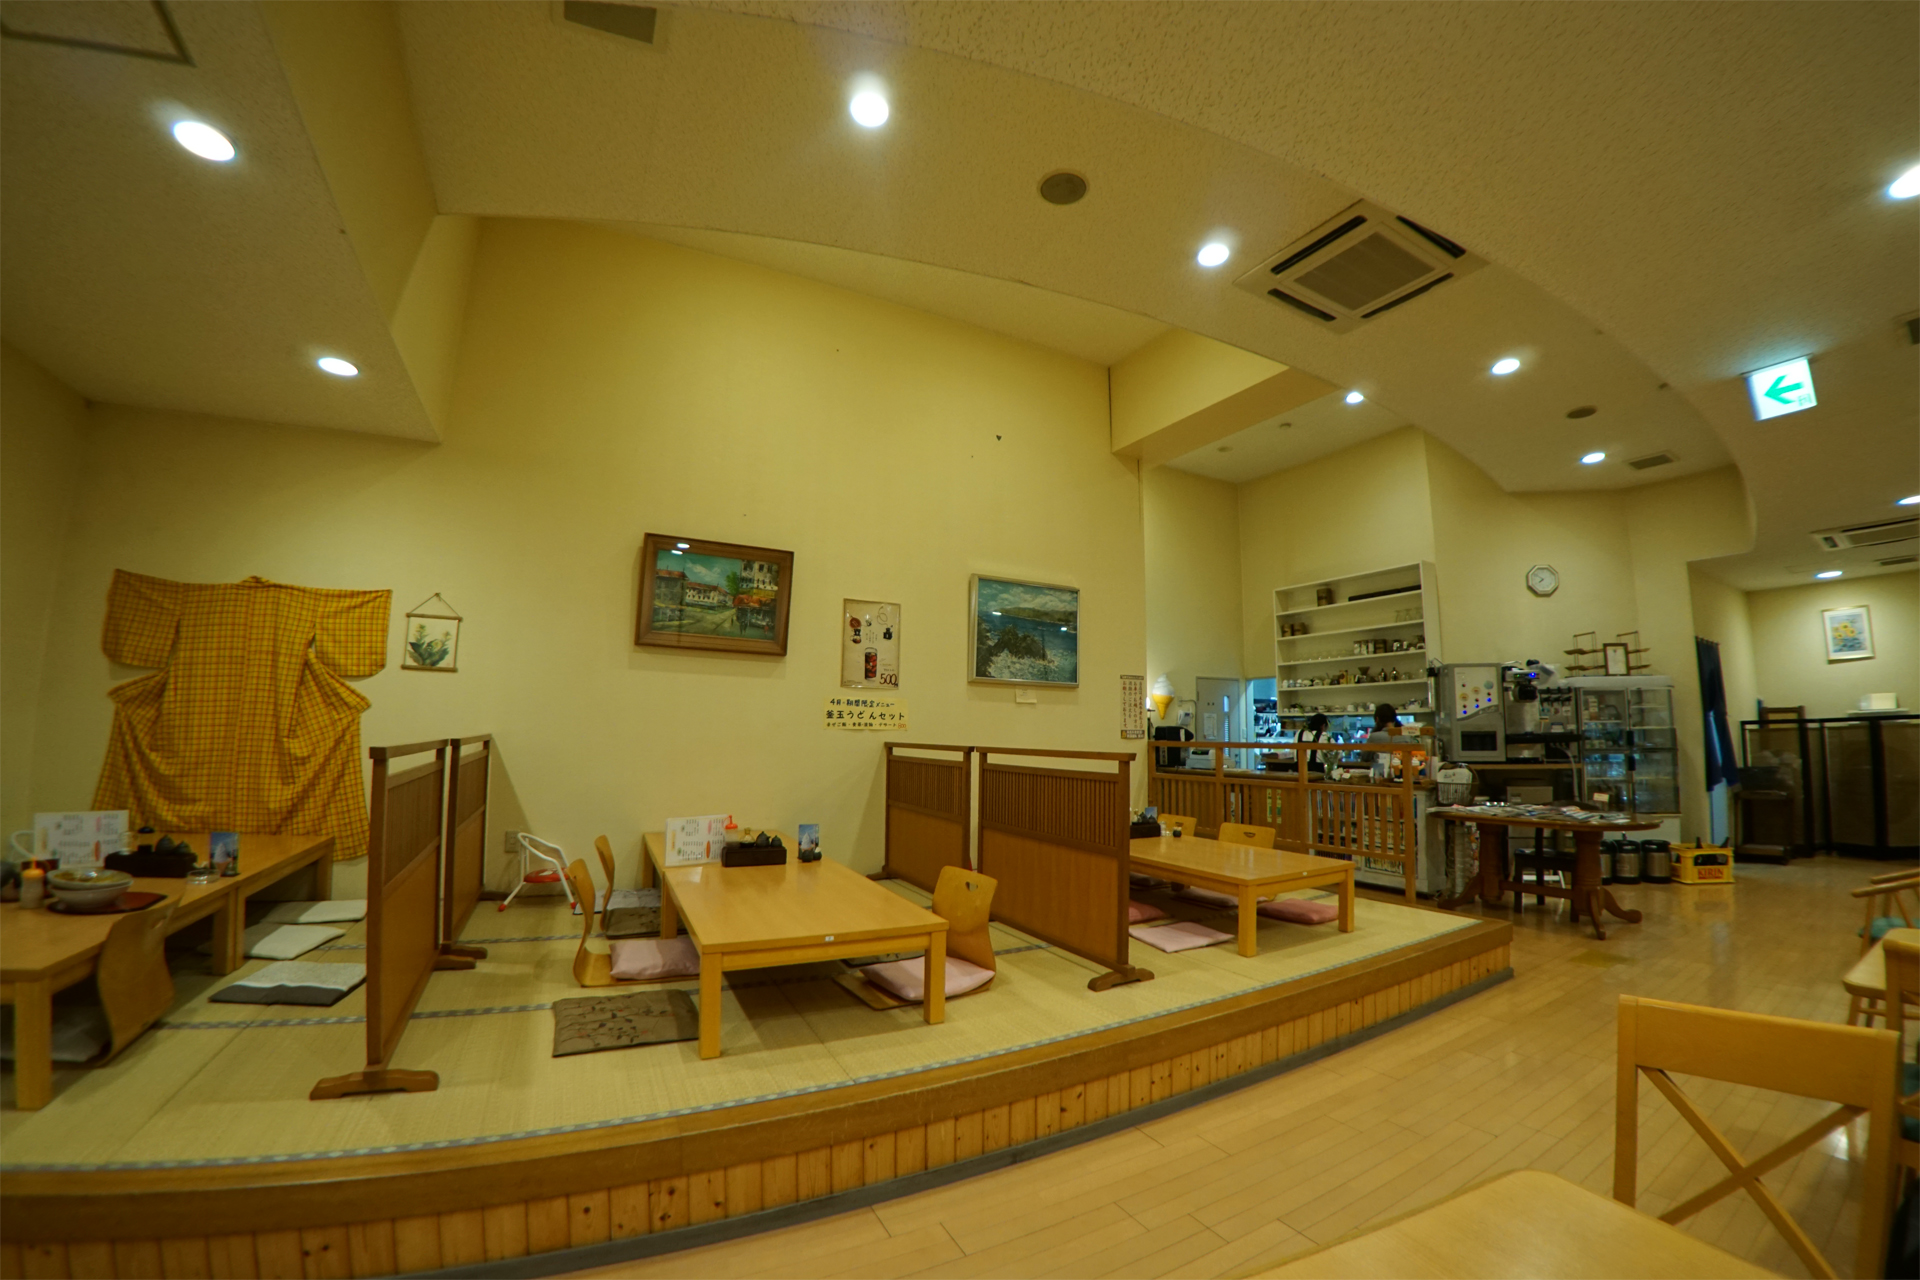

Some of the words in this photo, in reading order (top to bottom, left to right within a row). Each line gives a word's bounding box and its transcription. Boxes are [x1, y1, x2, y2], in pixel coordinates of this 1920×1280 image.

[826, 710, 905, 720] 釜玉うどんセット
[1698, 868, 1723, 877] KIRIN
